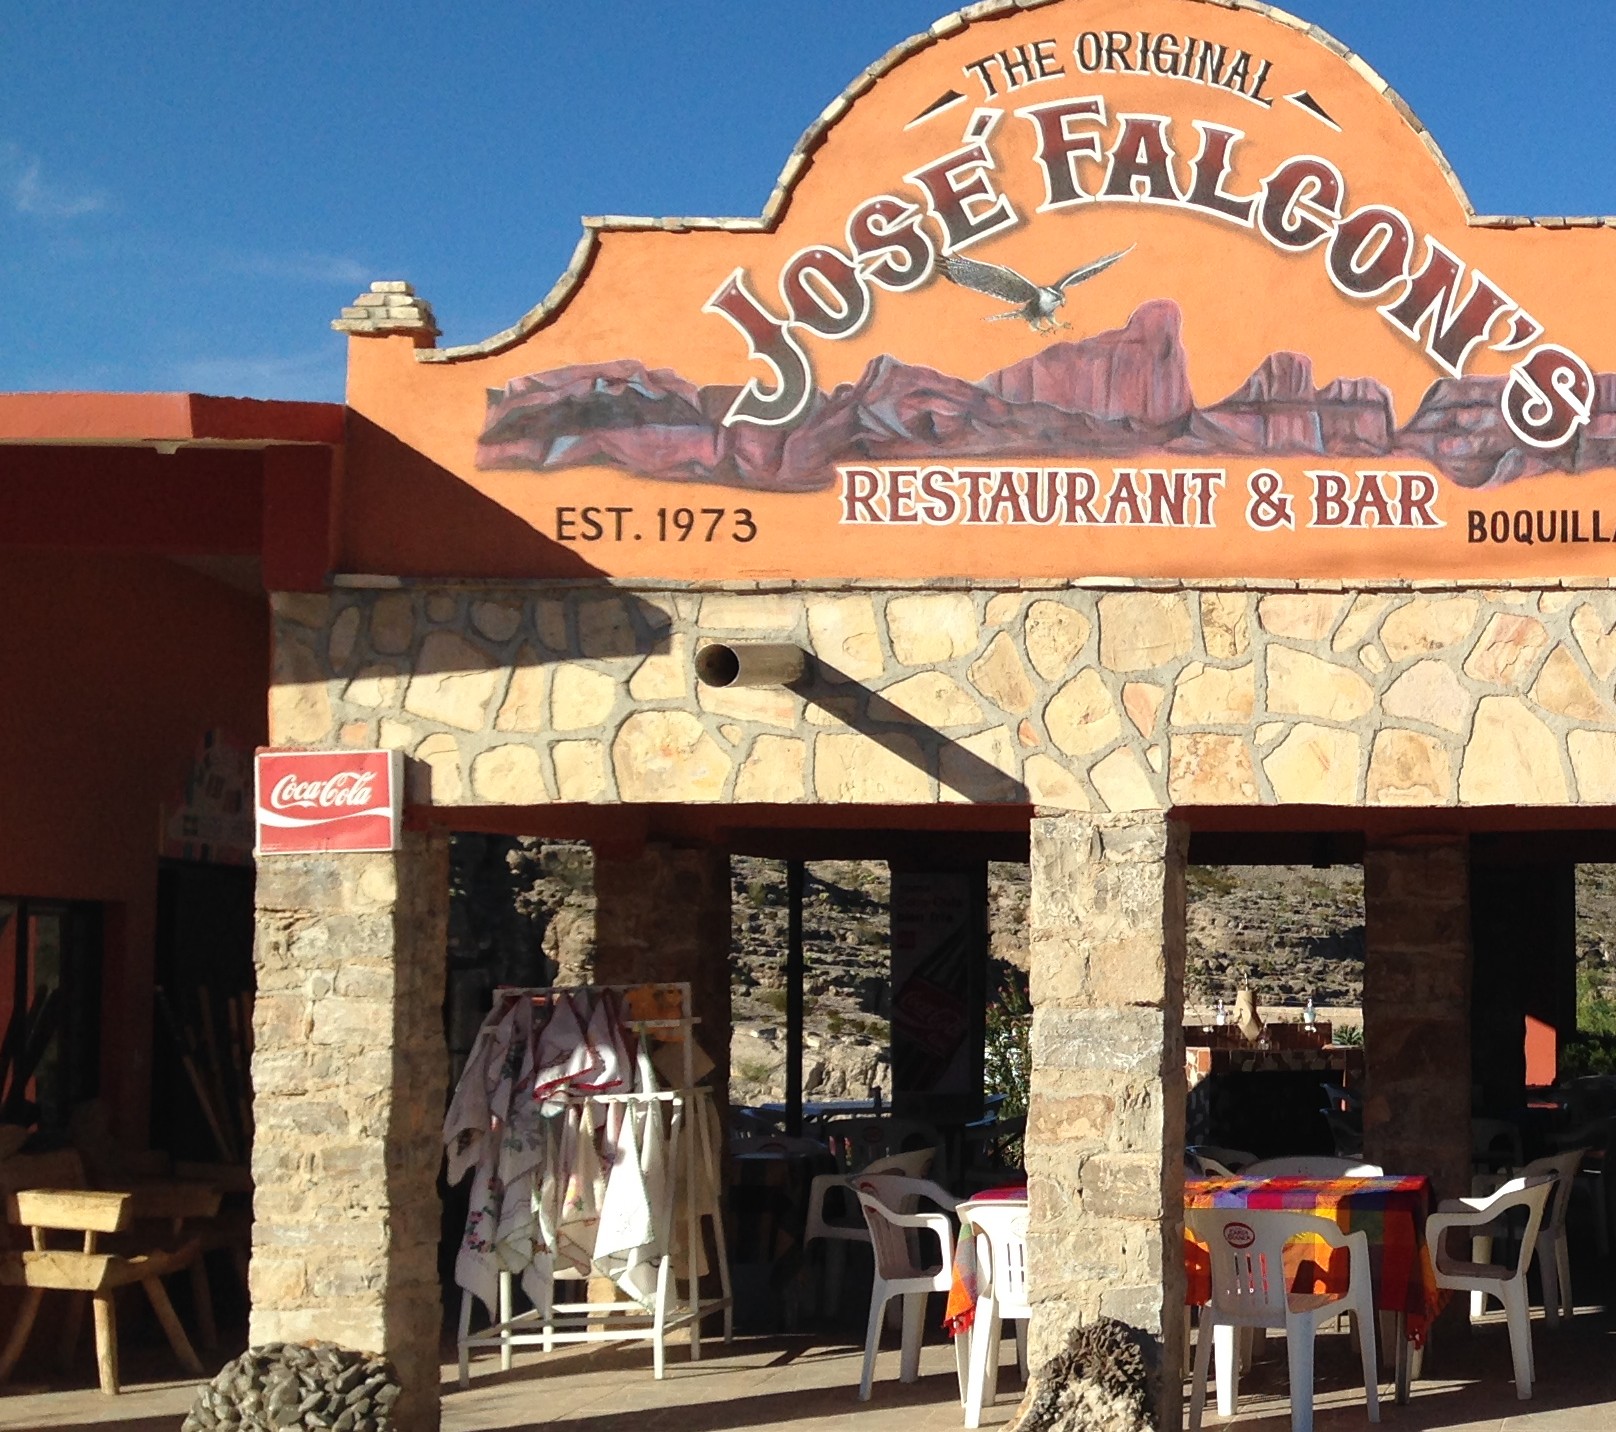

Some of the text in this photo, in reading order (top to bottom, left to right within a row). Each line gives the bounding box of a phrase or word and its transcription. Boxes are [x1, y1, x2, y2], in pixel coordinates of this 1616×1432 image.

[965, 31, 1277, 107] THE ORIGINAL
[702, 97, 1595, 450] JOSÉ FALCON'S
[555, 507, 758, 544] EST. 1973
[838, 466, 1446, 531] RESTAURANT & BAR
[270, 771, 378, 810] Coca-Cola
